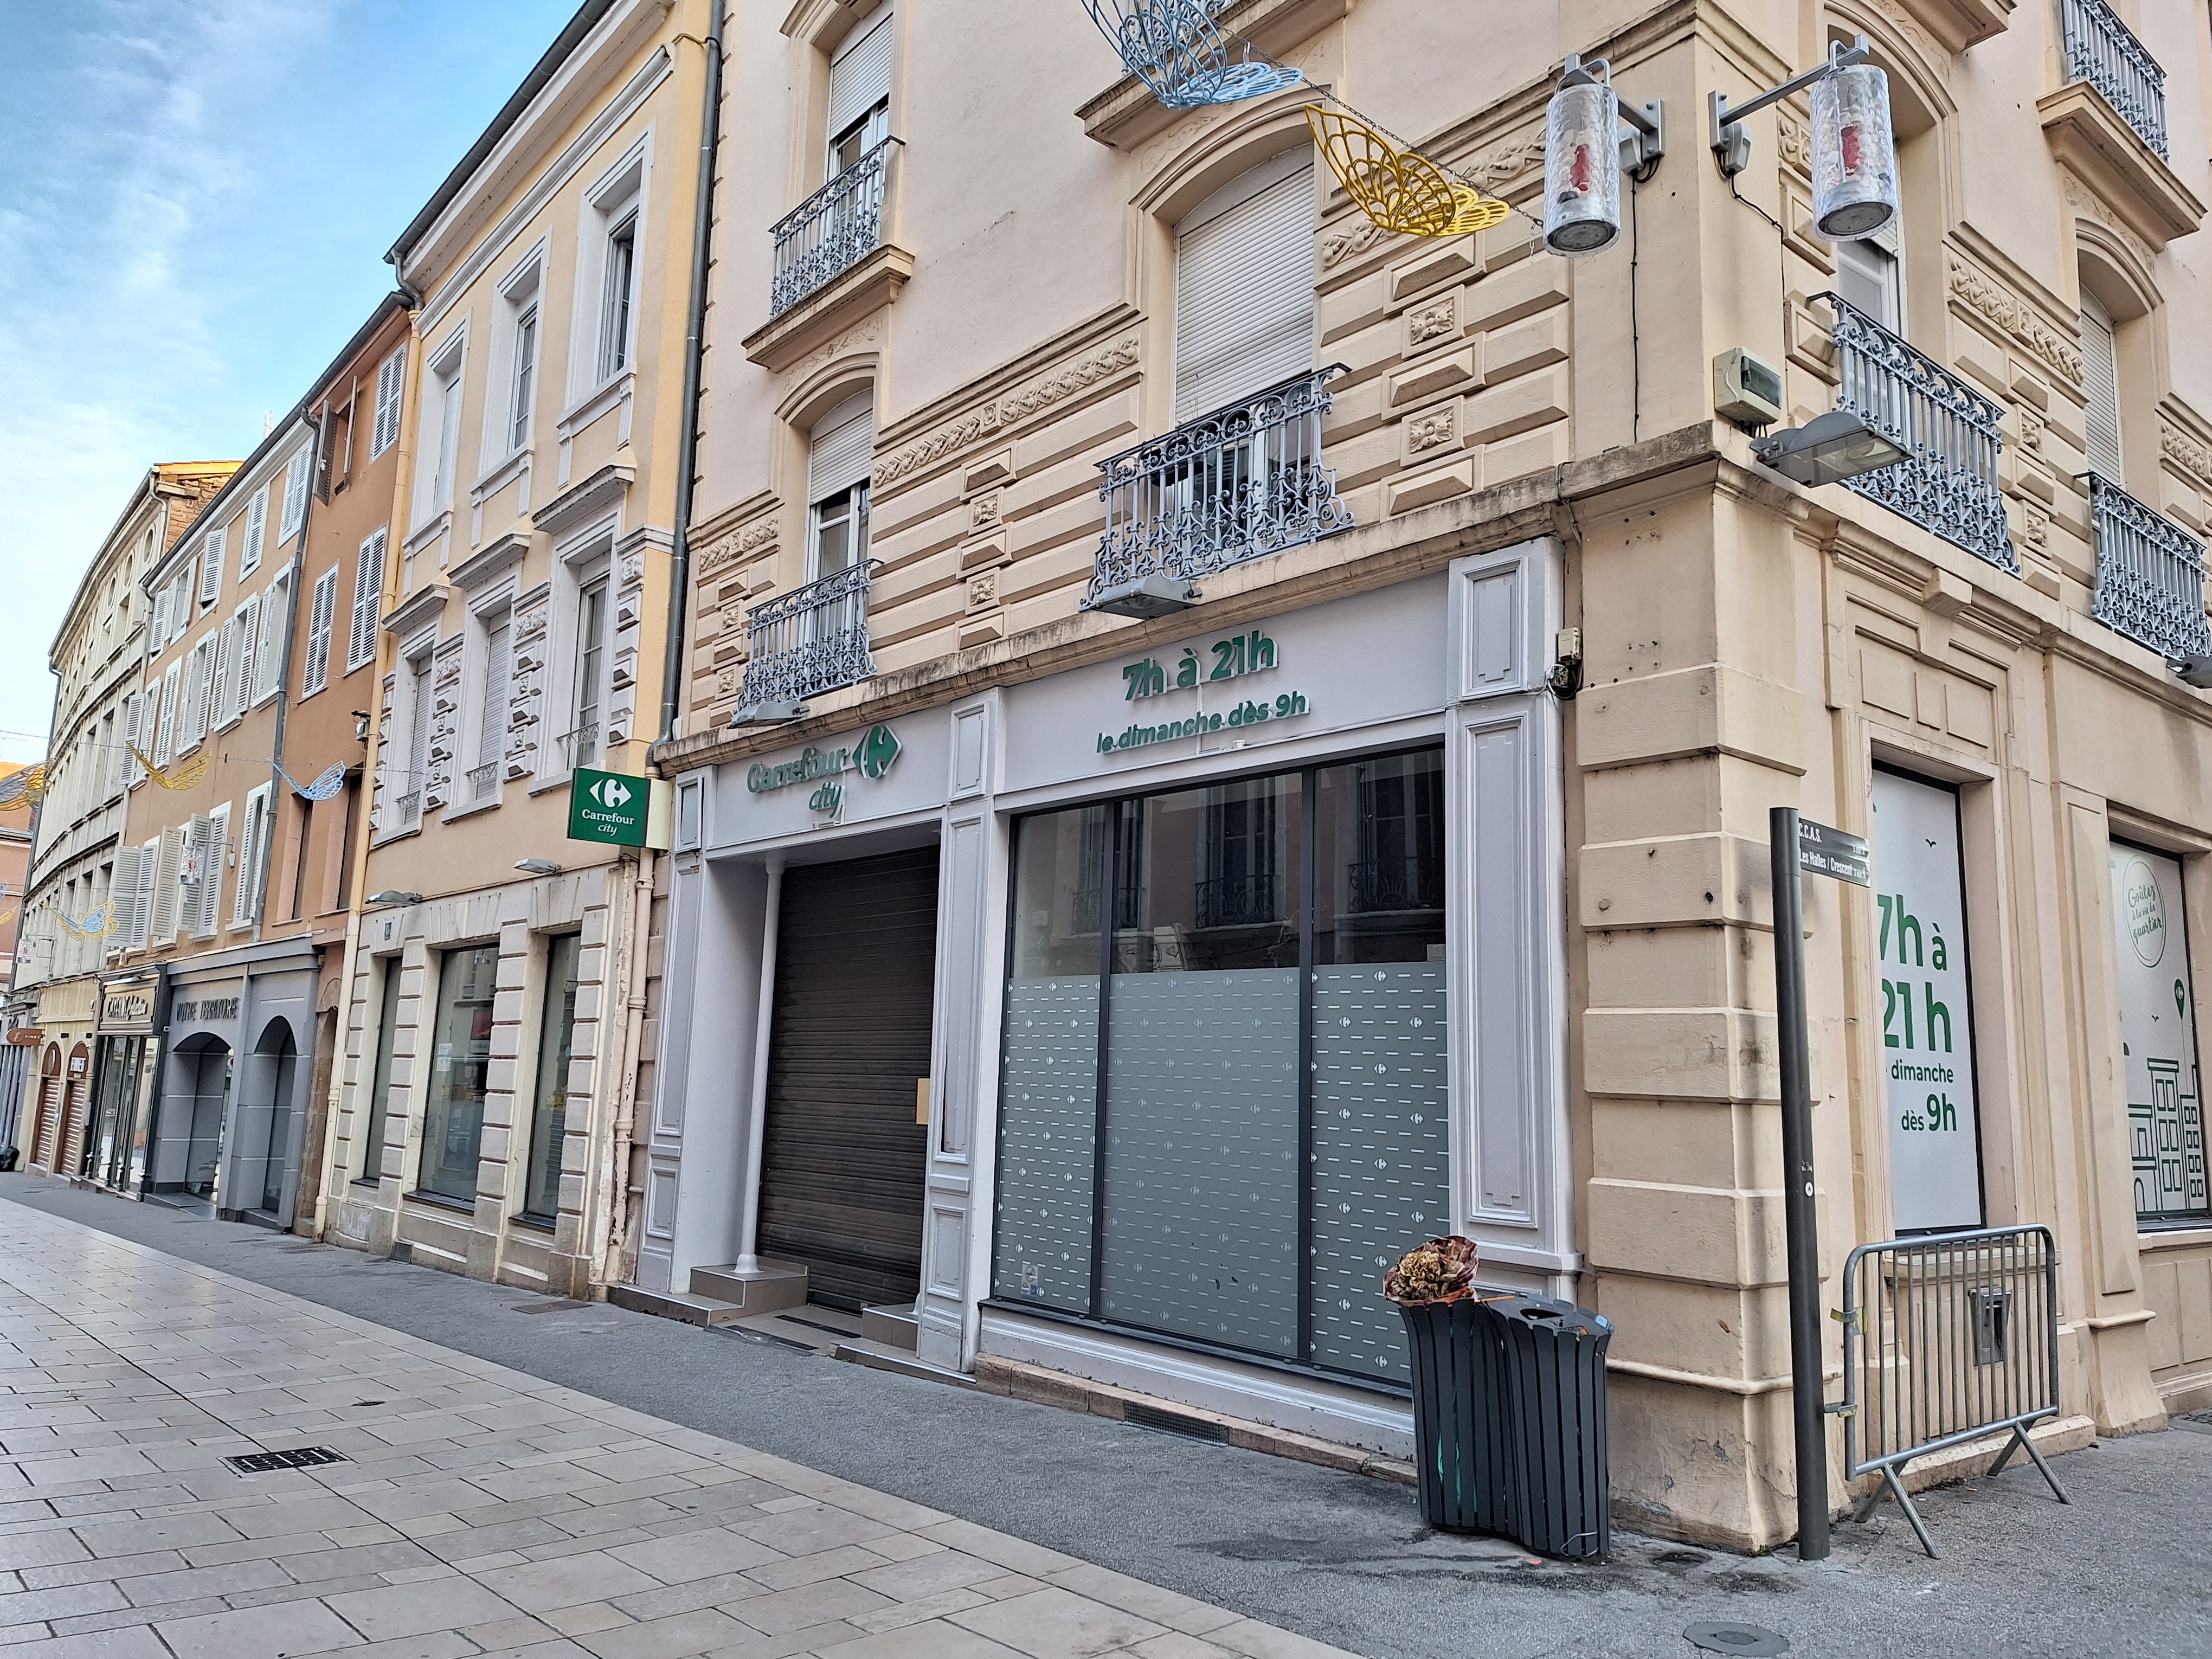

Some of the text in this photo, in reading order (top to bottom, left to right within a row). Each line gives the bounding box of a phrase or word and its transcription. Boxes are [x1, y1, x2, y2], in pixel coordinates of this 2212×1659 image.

[1122, 629, 1278, 702] 7h à 21h
[1096, 690, 1309, 754] le dimanche dès 9h
[747, 748, 850, 794] Carrefour
[808, 781, 845, 819] city
[582, 809, 635, 825] Carrefour
[597, 824, 618, 837] city
[1799, 822, 1822, 843] C.C.A.S.
[1799, 848, 1809, 864] Les
[1809, 851, 1827, 869] Halles
[1830, 857, 1853, 877] Crescent
[2128, 884, 2156, 908] Goûtez
[2149, 902, 2156, 912] de
[1877, 893, 1947, 971] 7h à
[2133, 916, 2162, 945] quartier
[1891, 1059, 1954, 1083] dimanche
[1901, 1092, 1957, 1132] dès 9h
